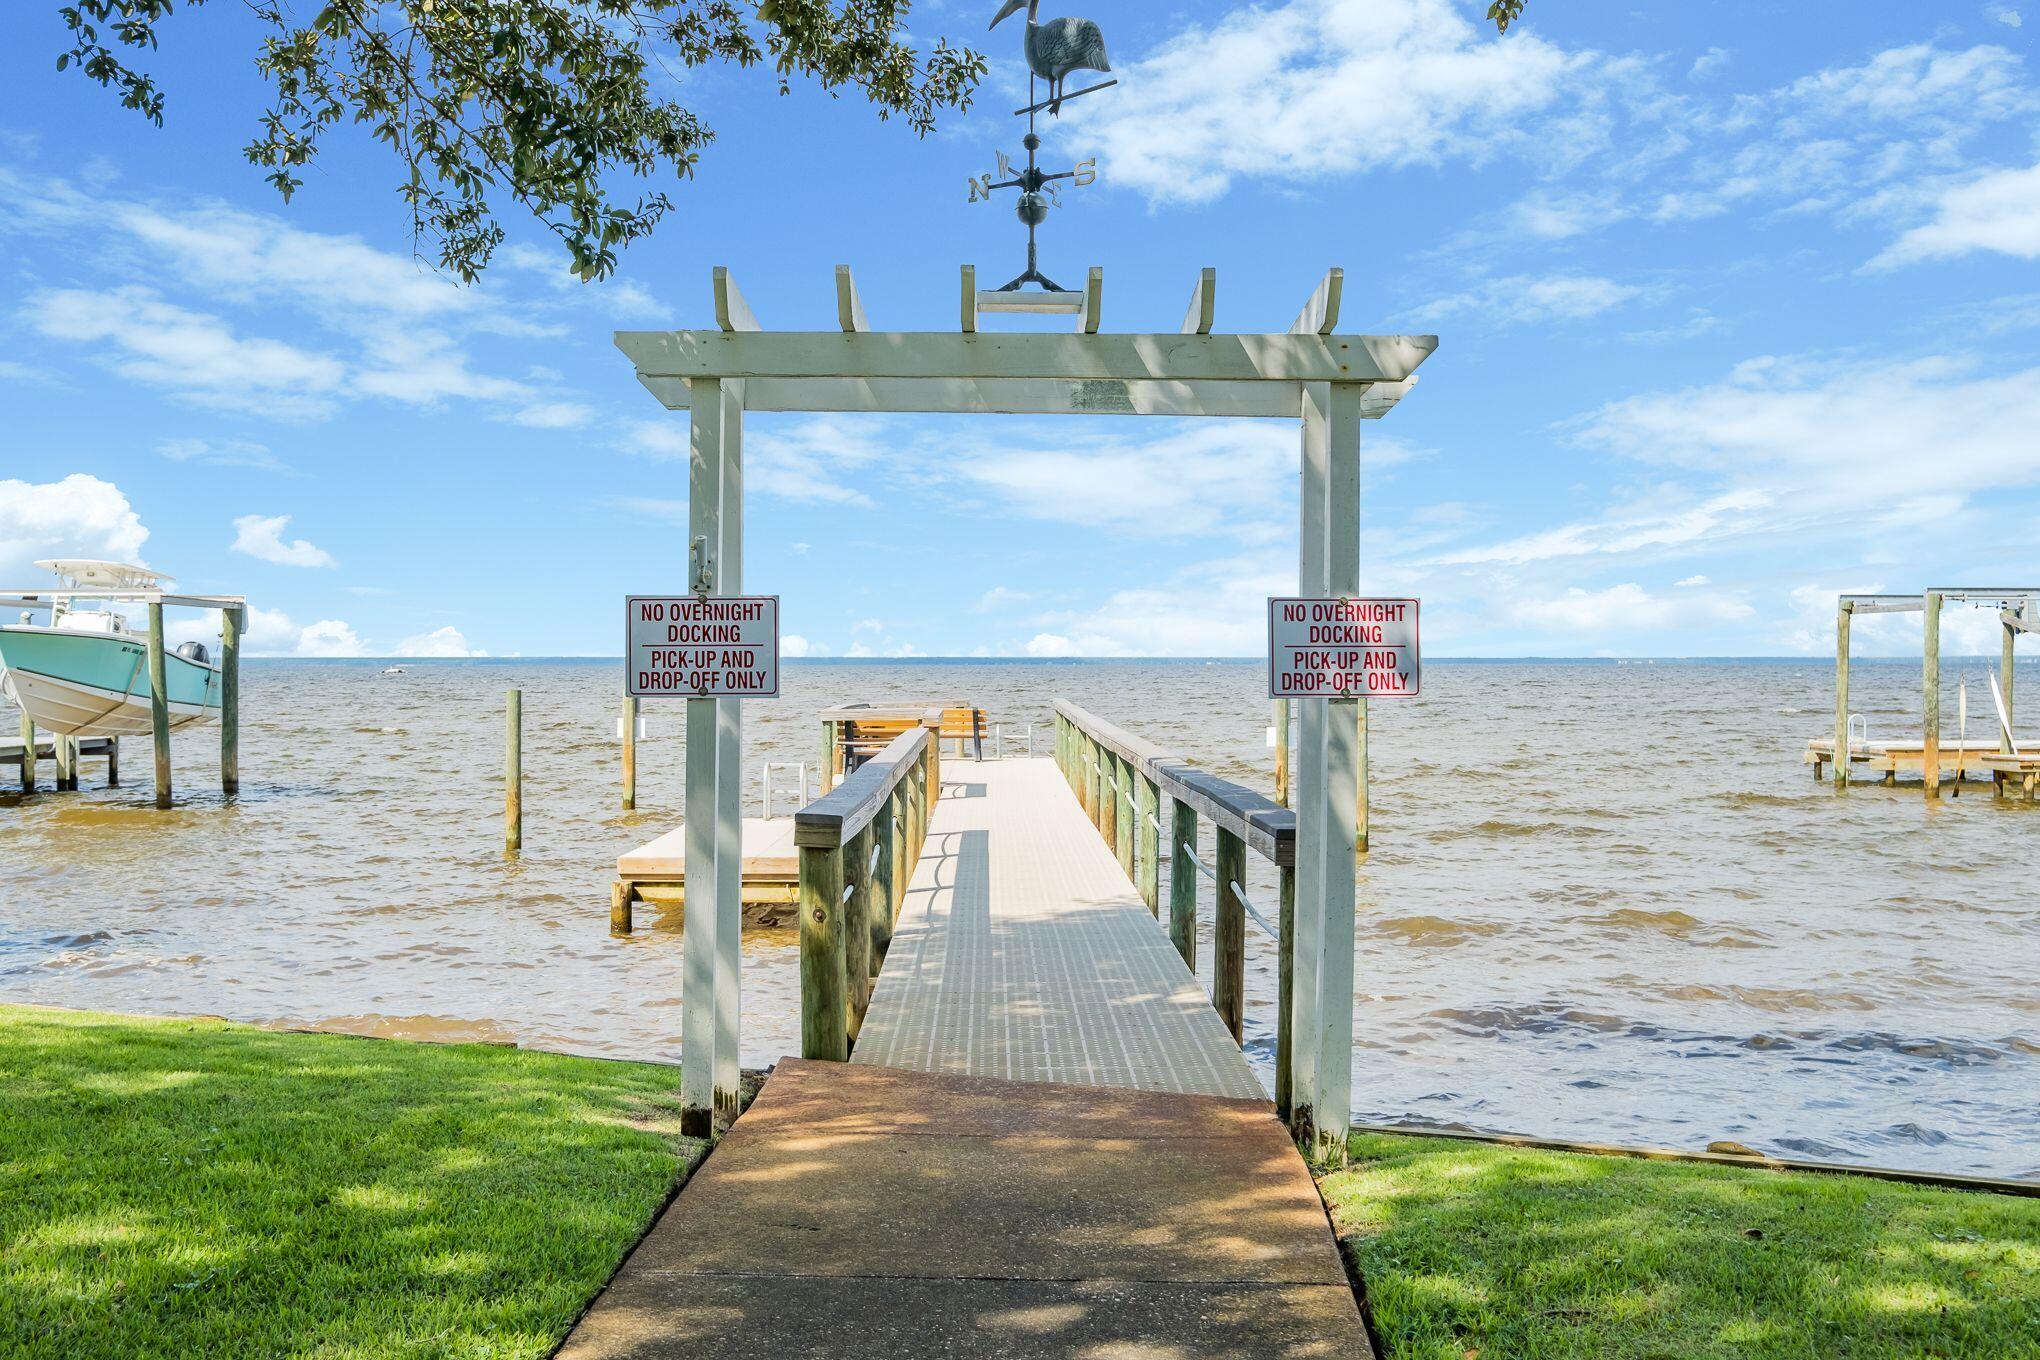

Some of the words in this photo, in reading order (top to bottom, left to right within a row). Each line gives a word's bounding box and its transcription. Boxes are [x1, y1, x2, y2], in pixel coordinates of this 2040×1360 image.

[1073, 157, 1096, 187] S
[968, 173, 991, 203] N
[641, 603, 664, 621] NO
[669, 603, 764, 621] OVERNIGHT
[1283, 604, 1306, 622] NO
[1312, 604, 1406, 622] OVERNIGHT
[668, 624, 741, 642] DOCKING
[1309, 625, 1383, 643] DOCKING
[651, 650, 717, 668] PICK-UP
[720, 650, 755, 668] AND
[1294, 651, 1359, 669] PICK-UP
[1363, 651, 1397, 669] AND
[639, 671, 720, 689] DROP-OFF
[725, 671, 767, 689] ONLY
[1281, 672, 1363, 690] DROP-OFF
[1368, 672, 1409, 690] ONLY
